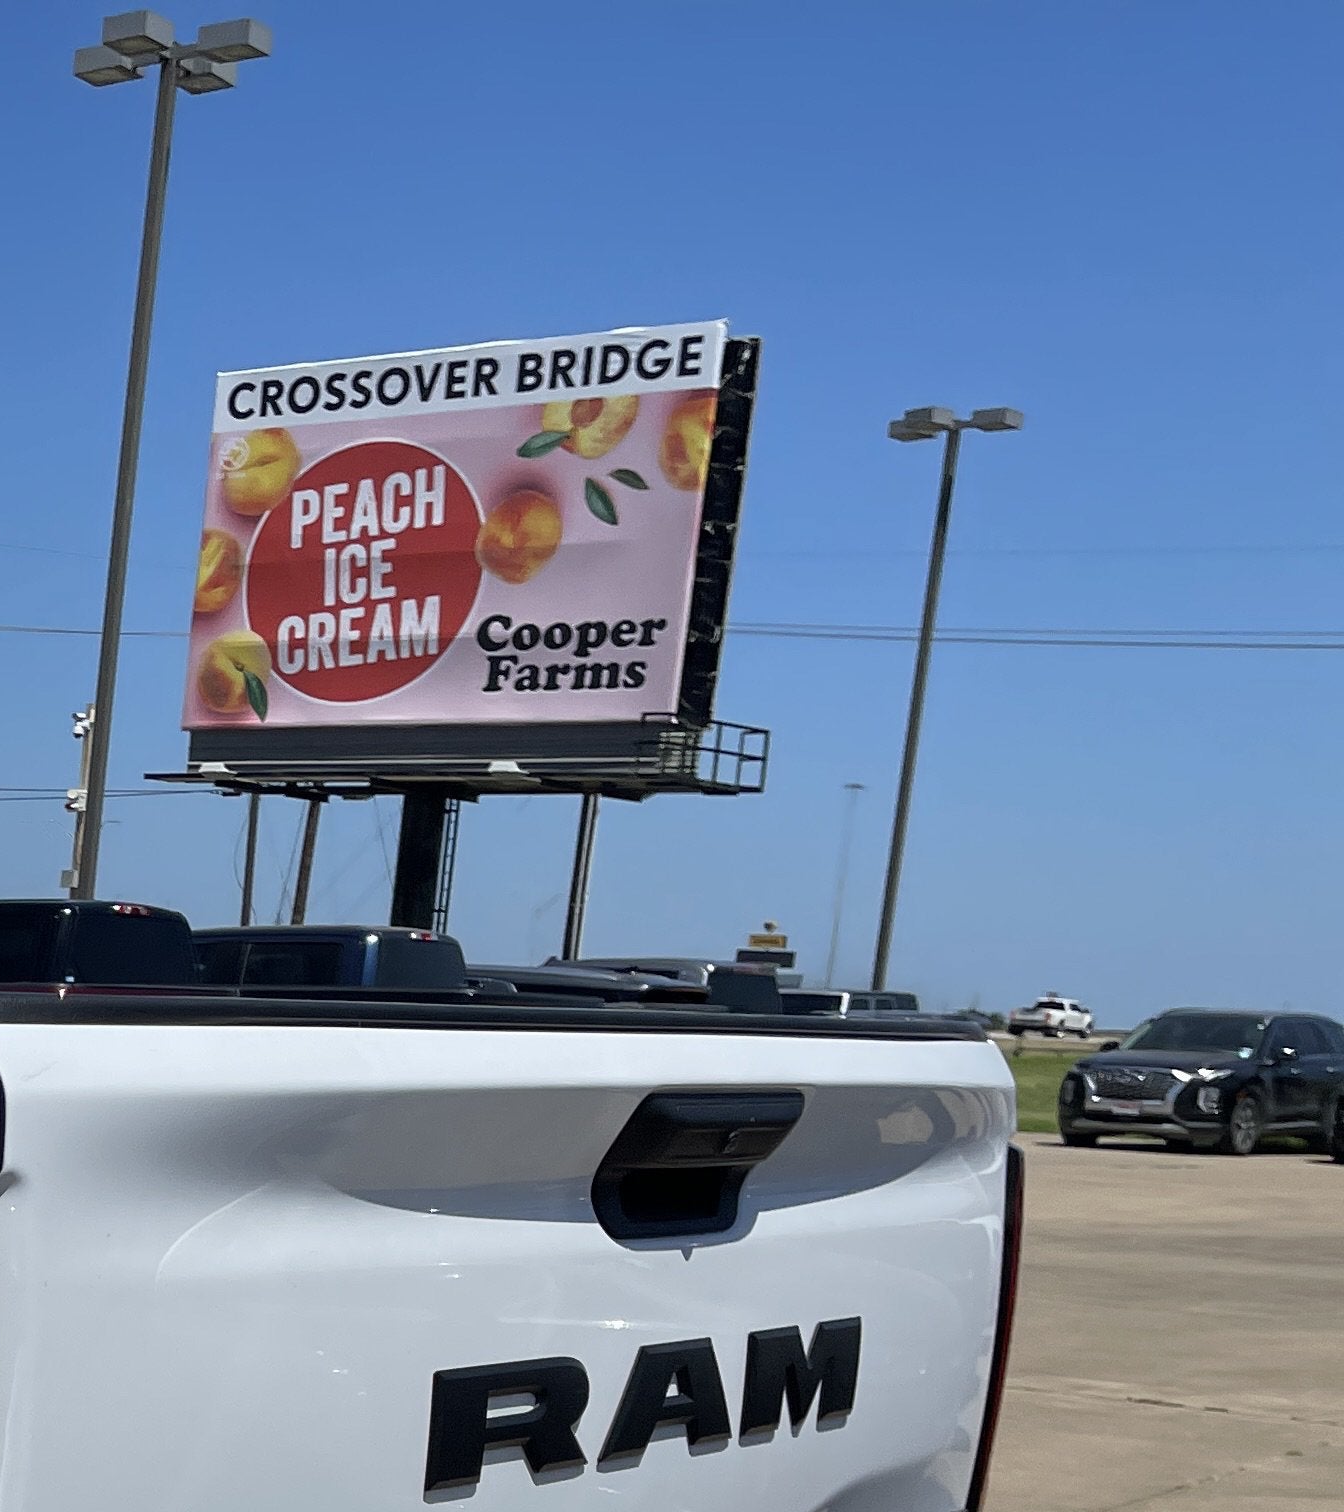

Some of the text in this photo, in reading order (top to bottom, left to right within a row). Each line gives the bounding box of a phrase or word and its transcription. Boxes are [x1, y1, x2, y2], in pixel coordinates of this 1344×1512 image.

[227, 334, 705, 421] CROSSOVER BRIDGE
[290, 464, 446, 549] PEACH
[323, 538, 397, 607] ICE
[276, 595, 442, 675] CREAM
[476, 614, 667, 657] Cooper
[482, 652, 647, 693] Farms
[424, 1316, 862, 1496] RAM
